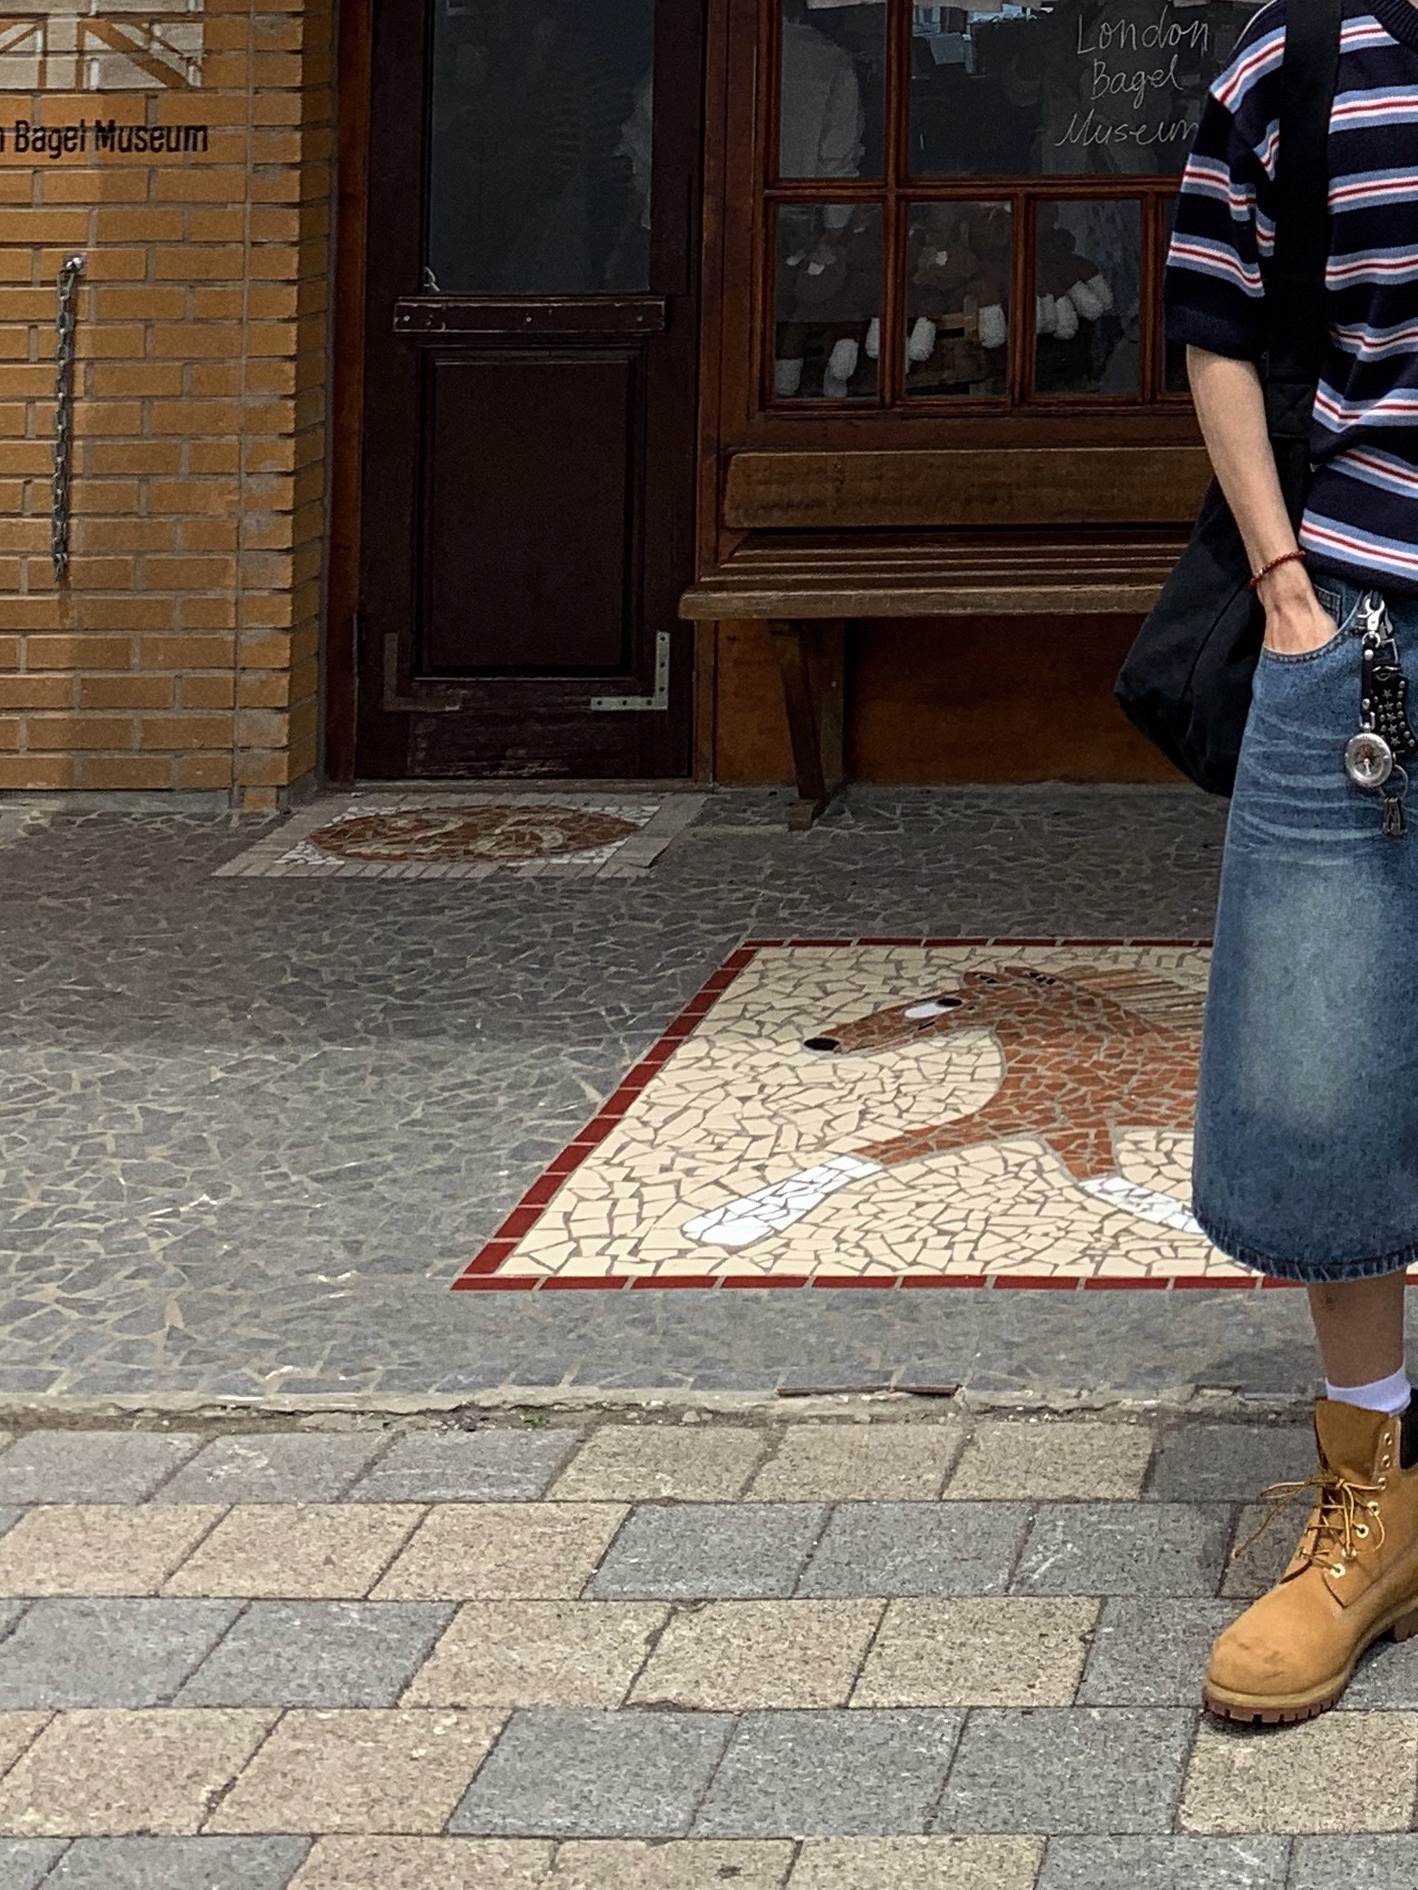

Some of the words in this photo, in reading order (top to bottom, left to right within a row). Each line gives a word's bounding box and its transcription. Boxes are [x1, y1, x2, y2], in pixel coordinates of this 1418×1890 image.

[1077, 5, 1209, 55] London
[1091, 55, 1184, 109] Bagel
[14, 119, 87, 160] Bagel
[95, 118, 209, 154] Museum
